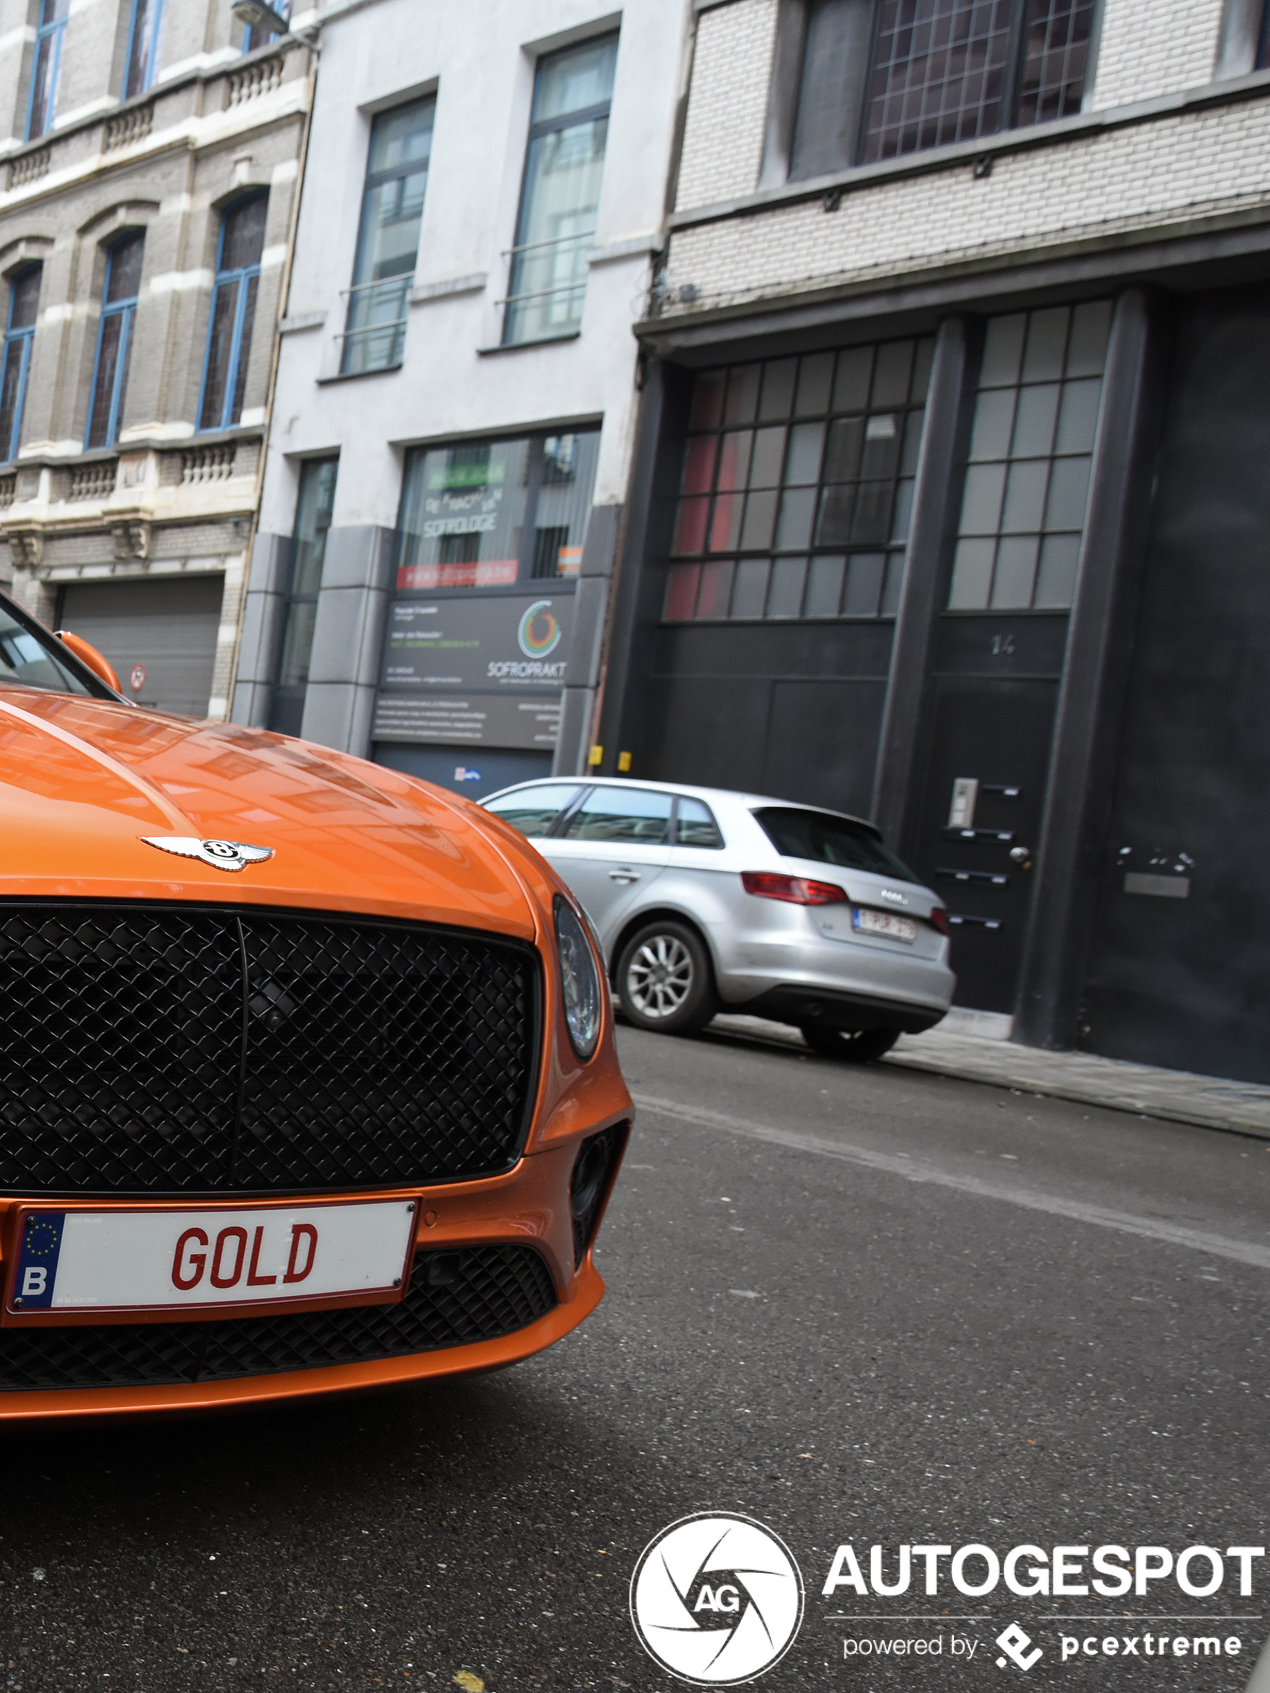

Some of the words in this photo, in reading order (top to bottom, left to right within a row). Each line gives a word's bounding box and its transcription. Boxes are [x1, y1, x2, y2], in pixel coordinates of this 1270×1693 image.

[423, 512, 498, 538] SOFROLOGE
[487, 661, 568, 678] SOFROPRAKT
[22, 1267, 47, 1295] B
[171, 1223, 318, 1291] GOLD
